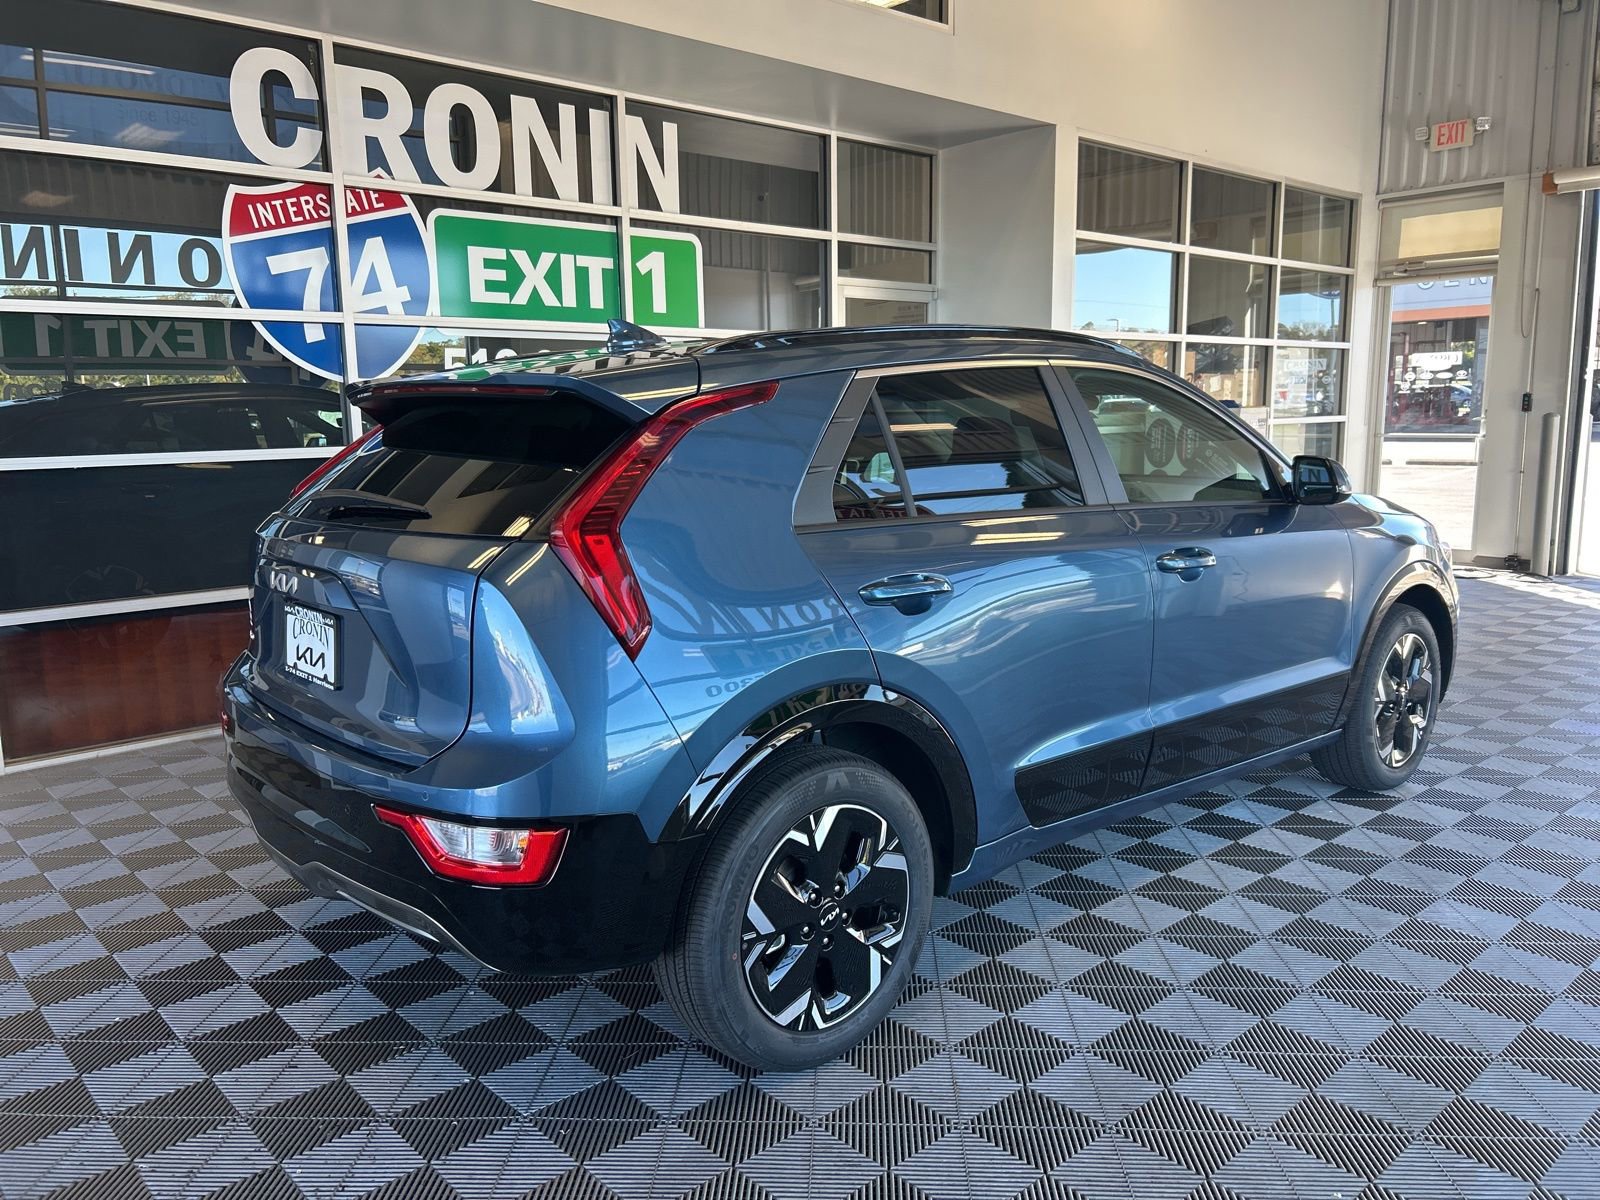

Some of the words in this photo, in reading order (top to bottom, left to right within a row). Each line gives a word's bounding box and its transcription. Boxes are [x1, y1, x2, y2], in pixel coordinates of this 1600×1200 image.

[229, 47, 679, 214] CRONIN
[1438, 121, 1467, 146] EXIT
[247, 188, 385, 229] INTERSATE
[265, 236, 412, 344] 74
[467, 246, 614, 309] EXIT
[635, 251, 667, 314] 1
[292, 617, 330, 650] CRONIN
